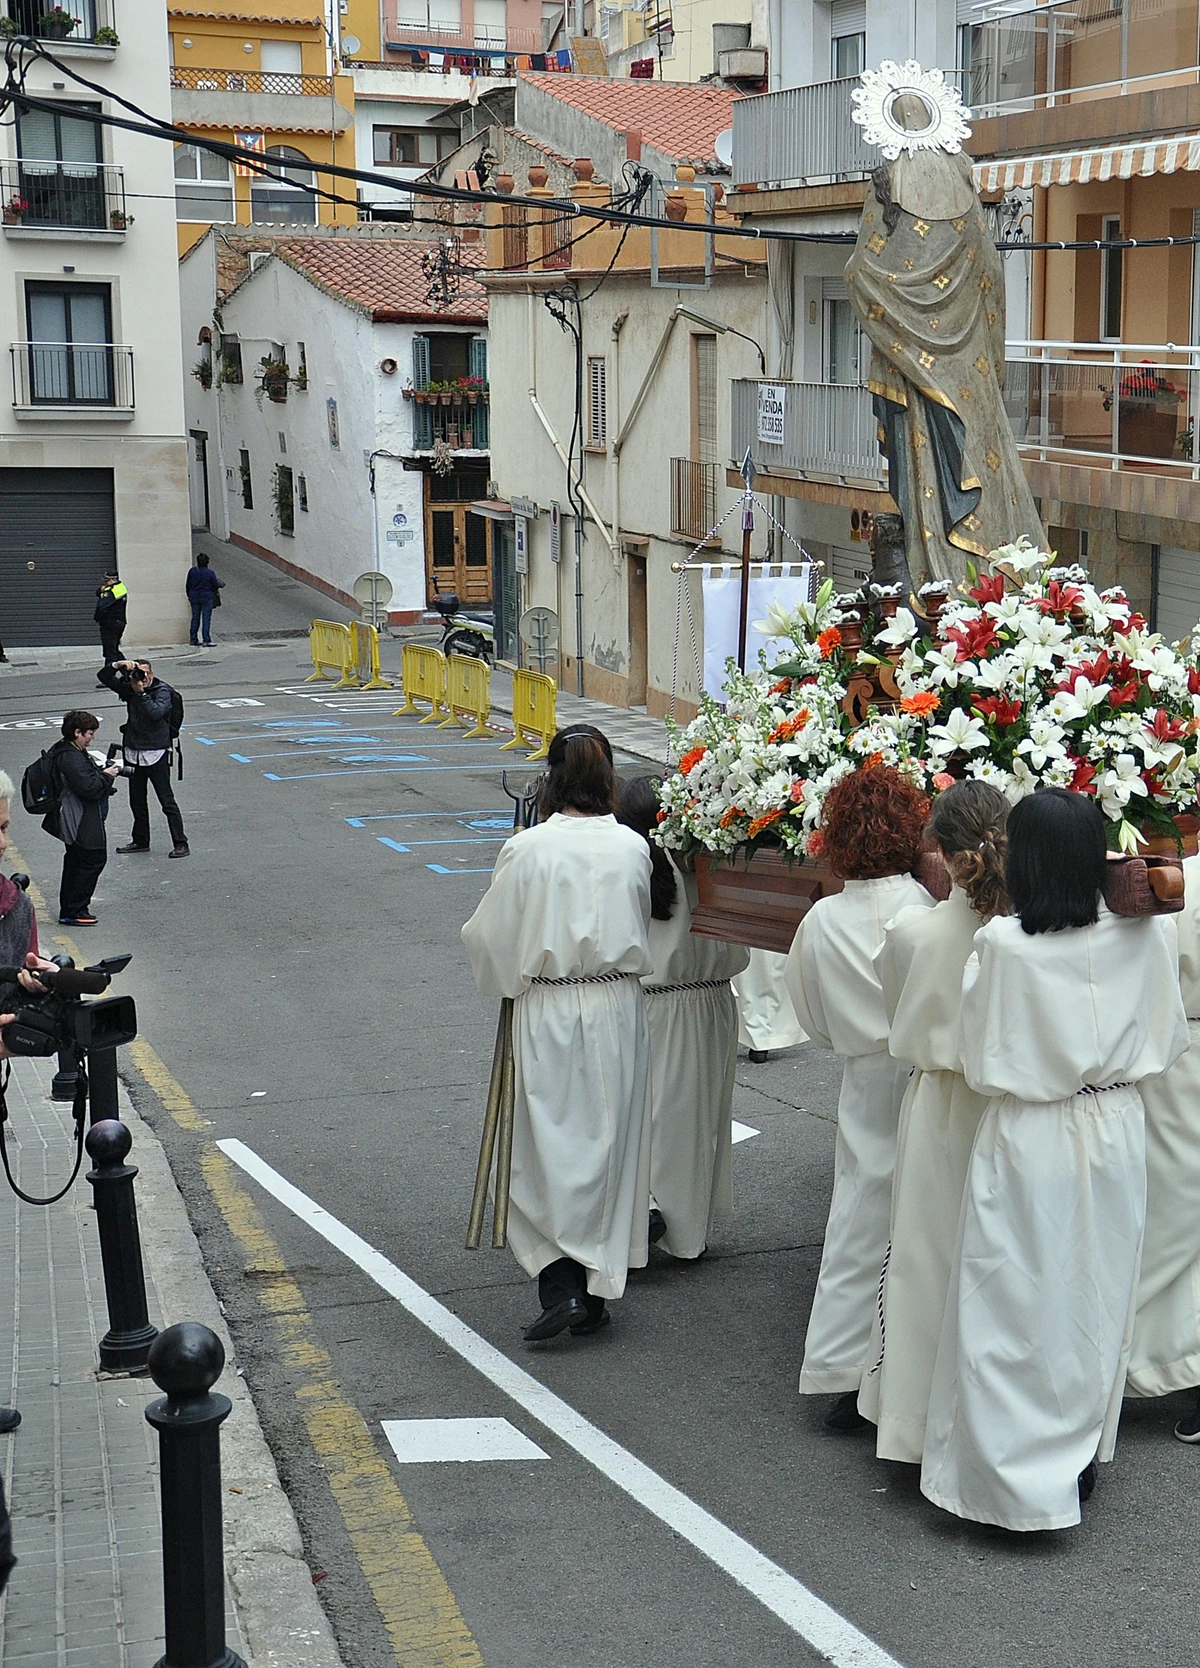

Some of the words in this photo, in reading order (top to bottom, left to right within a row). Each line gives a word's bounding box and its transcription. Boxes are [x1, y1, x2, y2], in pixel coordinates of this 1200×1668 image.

[768, 388, 775, 399] EN
[762, 400, 782, 414] VENDA
[16, 1036, 36, 1046] SONY
